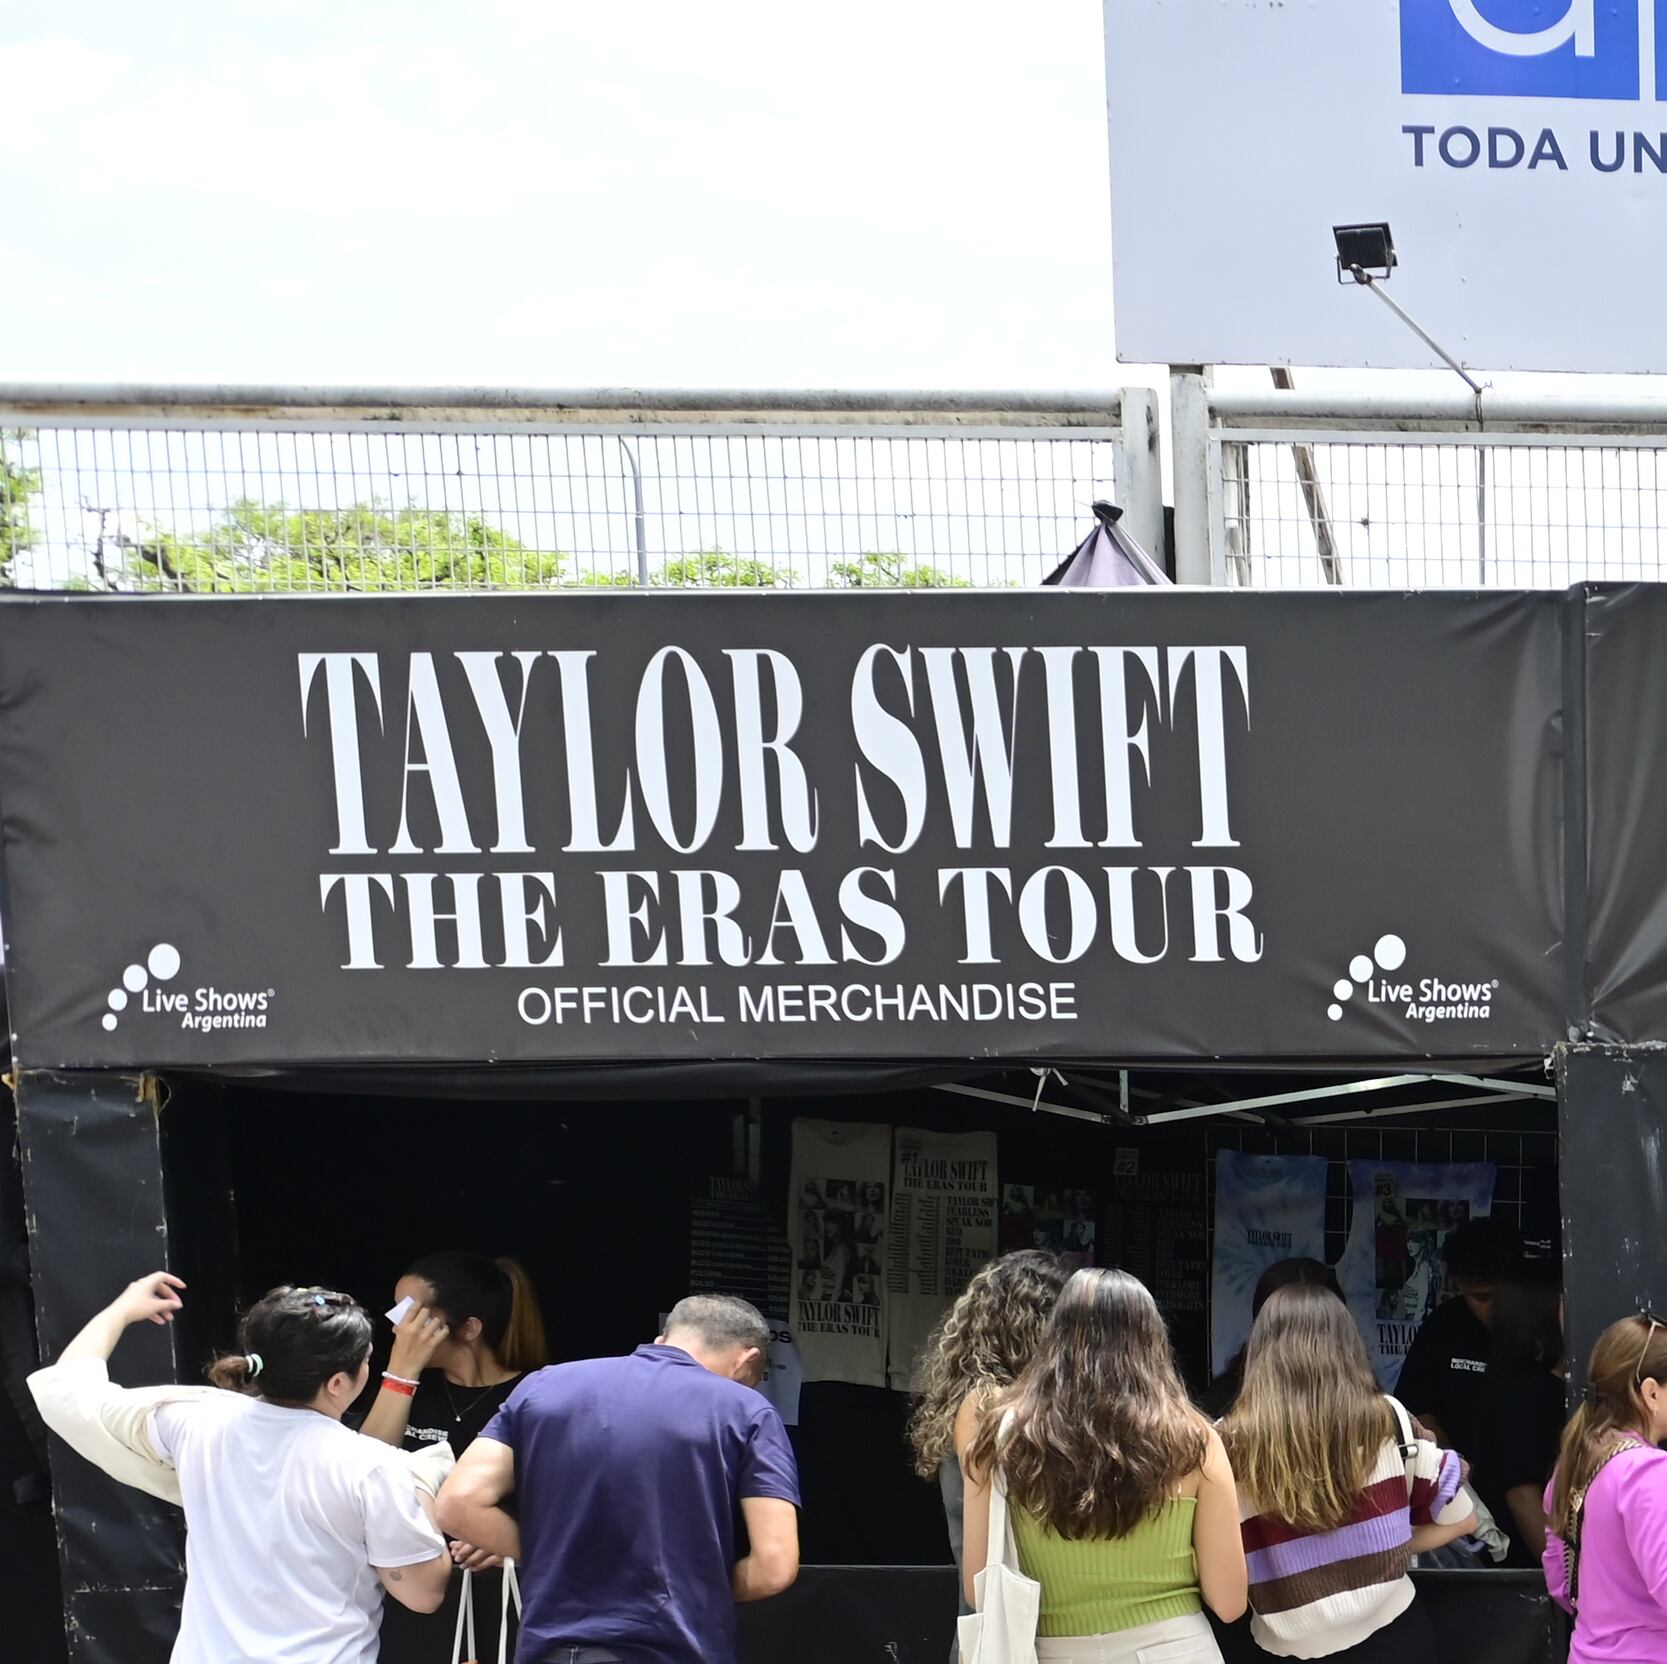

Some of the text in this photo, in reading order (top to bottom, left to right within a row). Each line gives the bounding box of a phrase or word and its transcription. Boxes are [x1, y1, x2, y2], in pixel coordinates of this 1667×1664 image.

[1402, 126, 1568, 170] TODA
[298, 644, 1250, 854] TAYLOR SWIFT
[320, 866, 1263, 969] THE ERAS TOUR
[143, 988, 187, 1013] Live
[1367, 979, 1411, 1002] Live
[518, 983, 1077, 1025] OFFICIAL MERCHANDISE
[1406, 1002, 1490, 1022] Argentina
[179, 1010, 266, 1032] Argentina
[950, 1160, 988, 1180] SWIFT
[958, 1181, 987, 1192] TOUR
[843, 1304, 880, 1326] SWIFT
[1377, 1324, 1418, 1344] TAYLO
